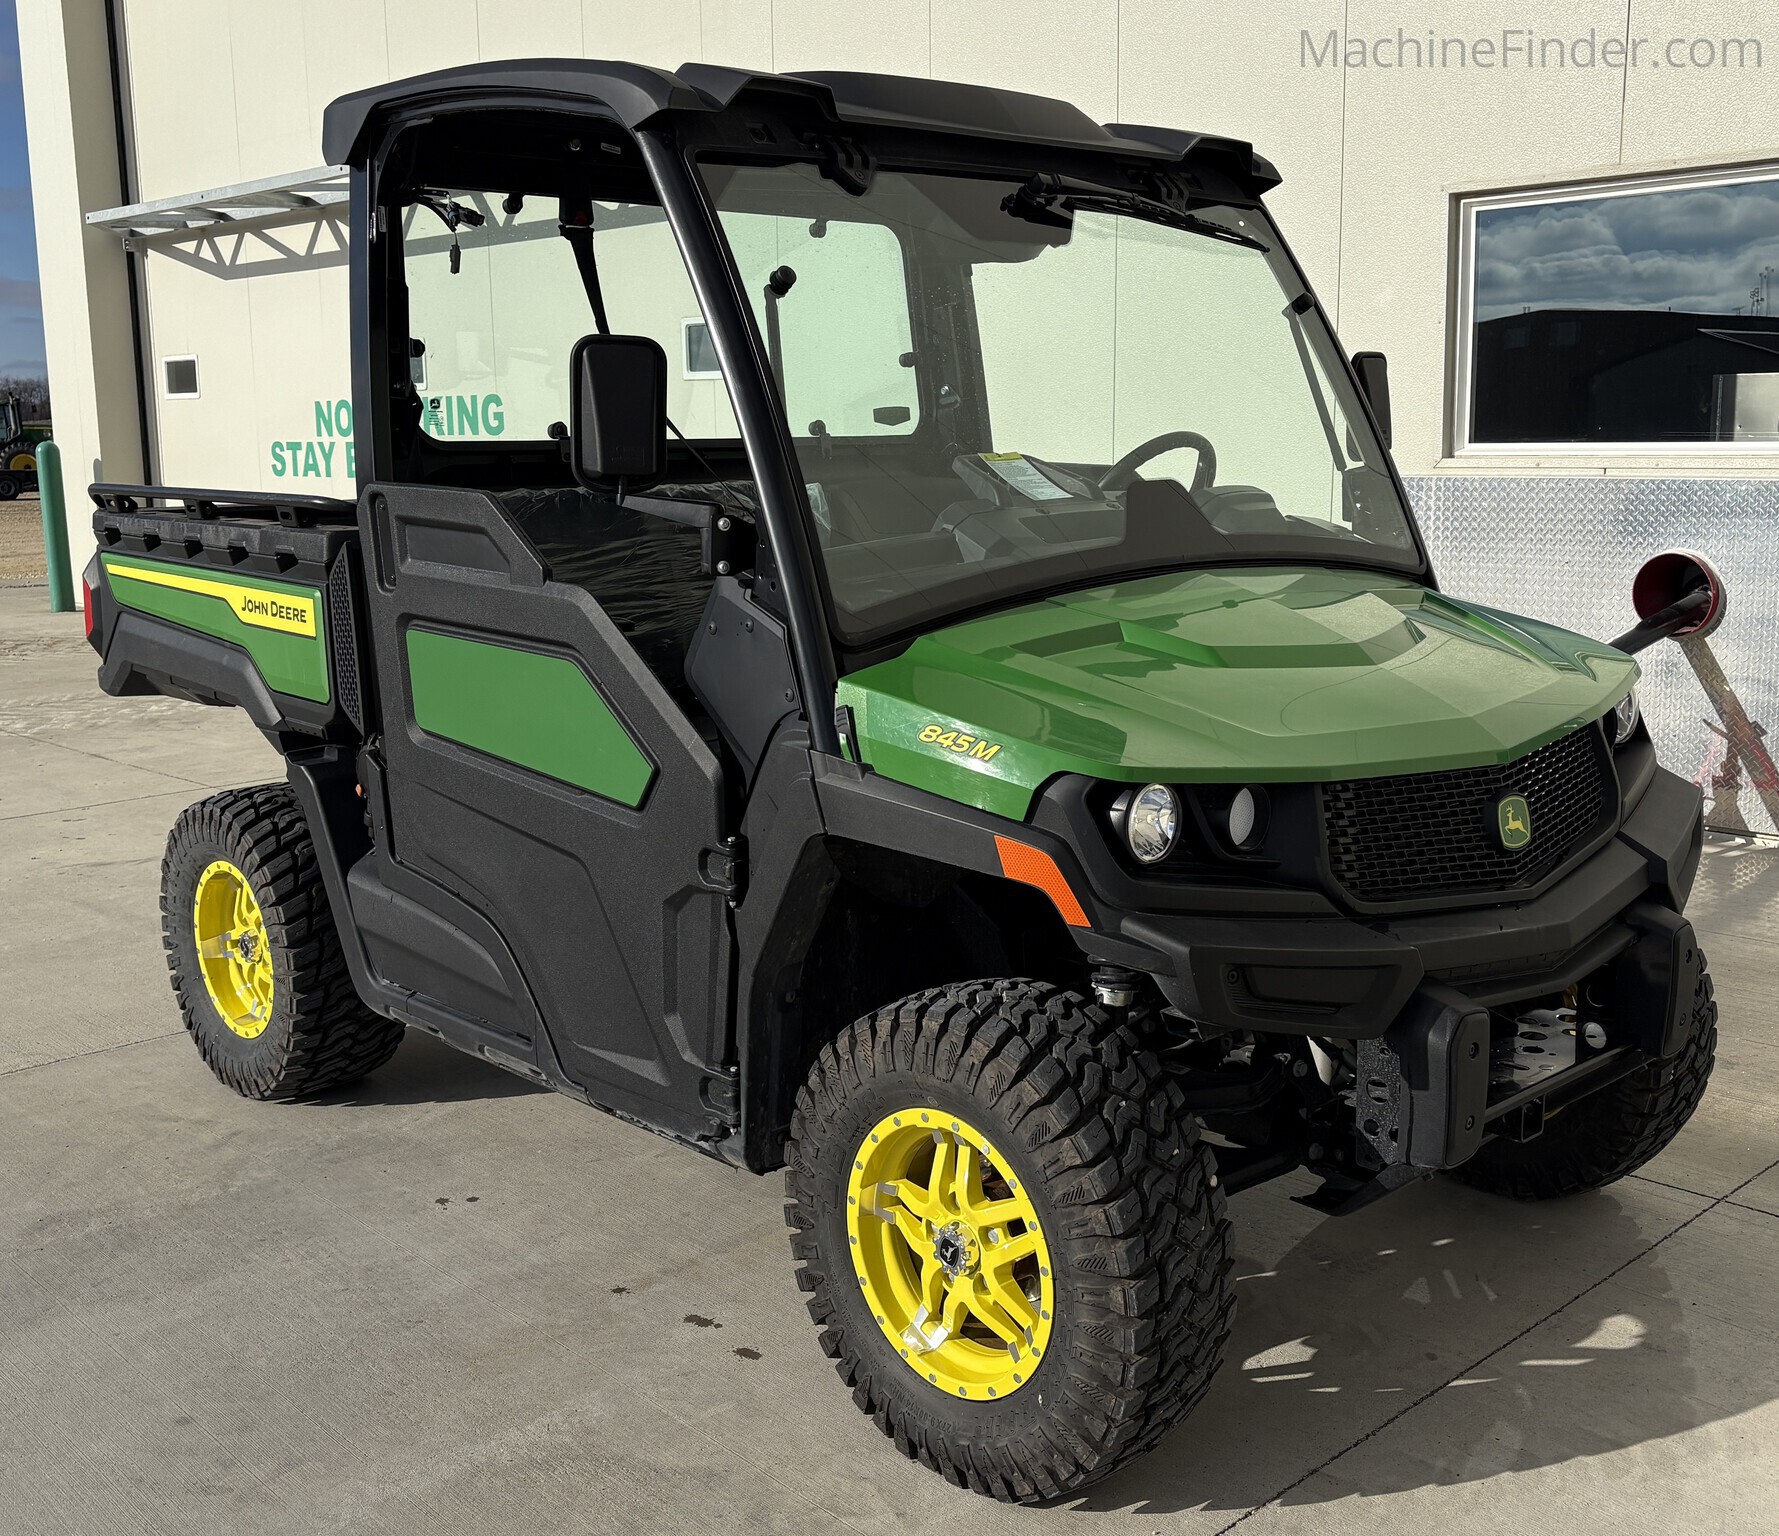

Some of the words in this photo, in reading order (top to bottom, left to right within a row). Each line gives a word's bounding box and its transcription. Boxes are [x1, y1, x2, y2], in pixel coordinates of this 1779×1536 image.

[314, 399, 353, 437] NO
[422, 393, 505, 436] KING
[271, 441, 335, 478] STAY
[241, 595, 269, 616] JOHN
[270, 600, 307, 623] DEERE
